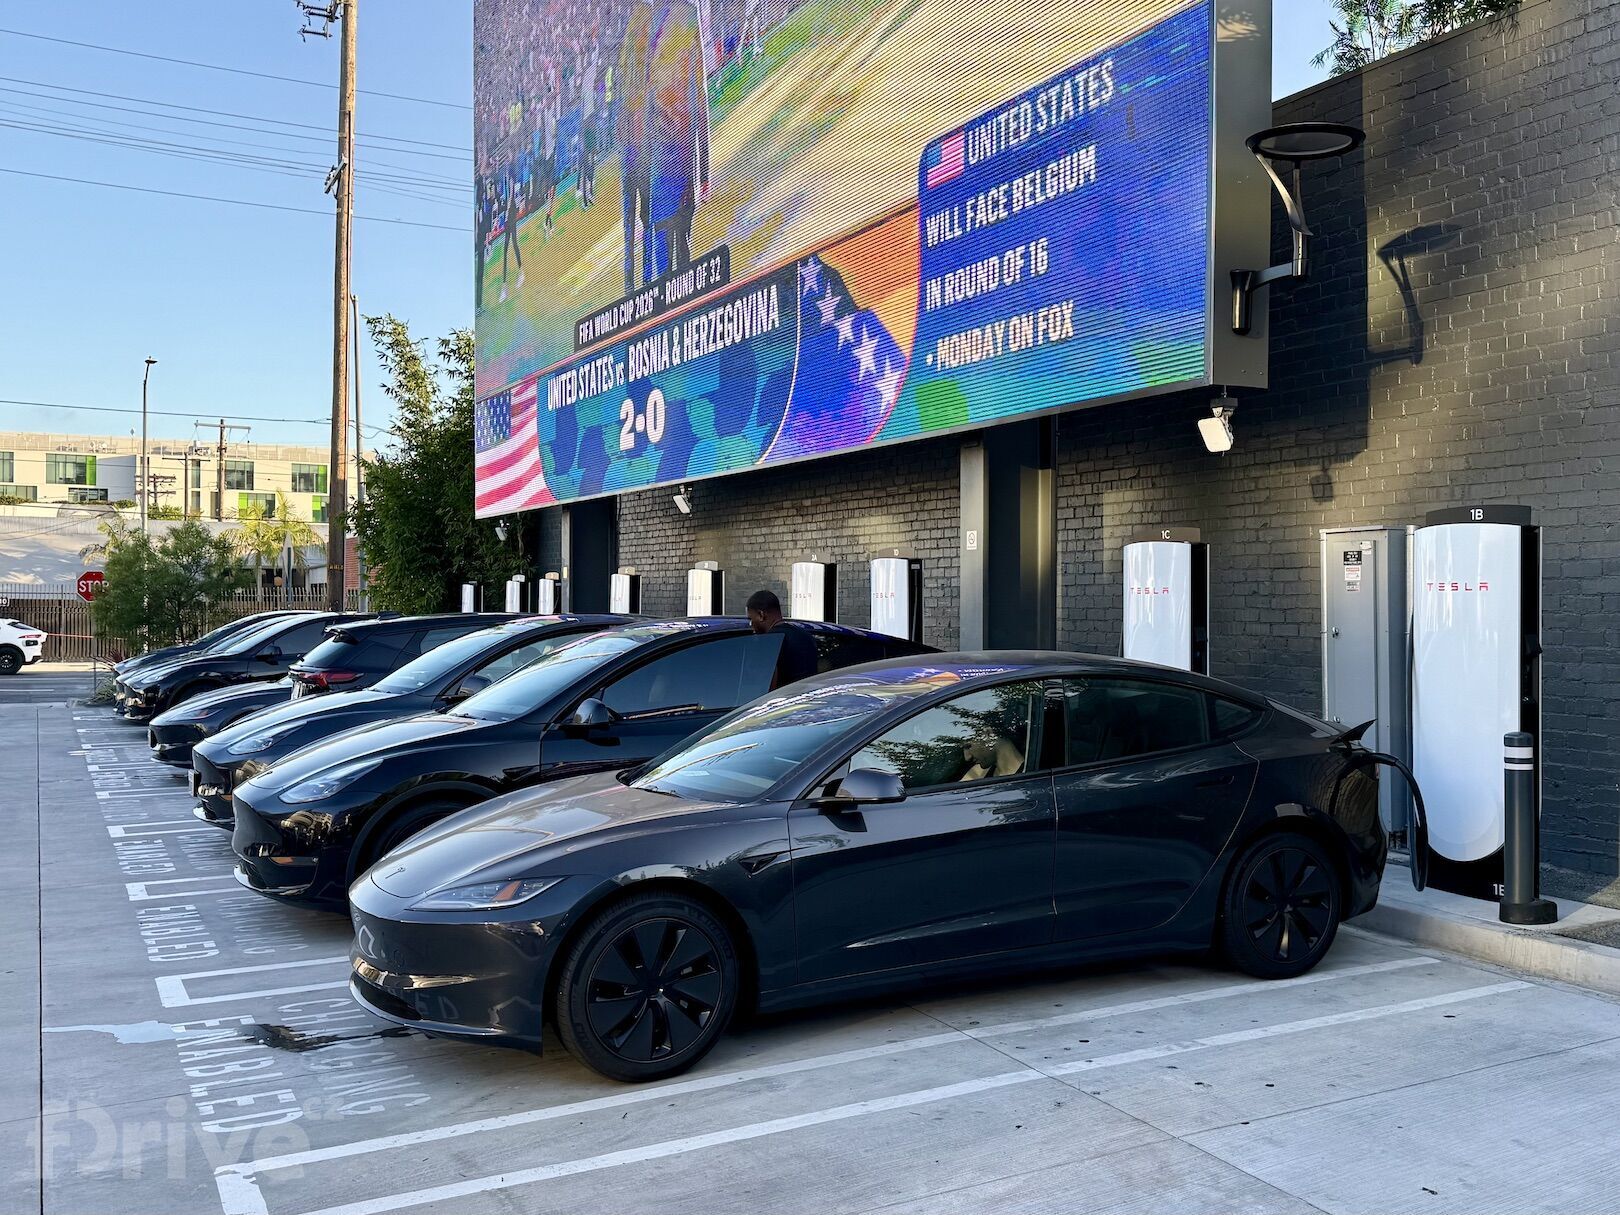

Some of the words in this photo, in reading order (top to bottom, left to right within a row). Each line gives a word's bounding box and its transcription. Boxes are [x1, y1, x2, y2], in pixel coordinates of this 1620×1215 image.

[968, 99, 1032, 165] UNITED
[1036, 58, 1114, 135] STATES
[926, 206, 963, 248] WILL
[966, 184, 1009, 232] FACE
[1012, 144, 1097, 213] BELGIUM
[579, 318, 594, 345] FIFA
[594, 306, 619, 337] WORLD
[619, 299, 634, 327] CUP
[665, 268, 695, 306] ROUND
[696, 262, 708, 291] OF
[709, 255, 721, 284] 32
[926, 275, 942, 312] IN
[944, 256, 1000, 307] ROUND
[1003, 244, 1026, 286] OF
[1029, 236, 1049, 278] 16
[547, 369, 577, 412] UNITED
[578, 353, 614, 400] STATES
[628, 331, 670, 383] BOSNIA
[672, 325, 681, 366] &
[683, 284, 780, 363] HERZEGOVINA
[937, 319, 1007, 371] MONDAY
[1008, 311, 1034, 352] ON
[1037, 299, 1074, 346] FOX
[1161, 529, 1171, 540] 1C
[1470, 508, 1484, 521] 1B
[79, 580, 110, 593] STOP
[1130, 586, 1169, 595] TESLA
[1427, 582, 1489, 591] TESLA
[136, 904, 220, 962] ENABLED
[171, 1014, 303, 1133] ENABLED
